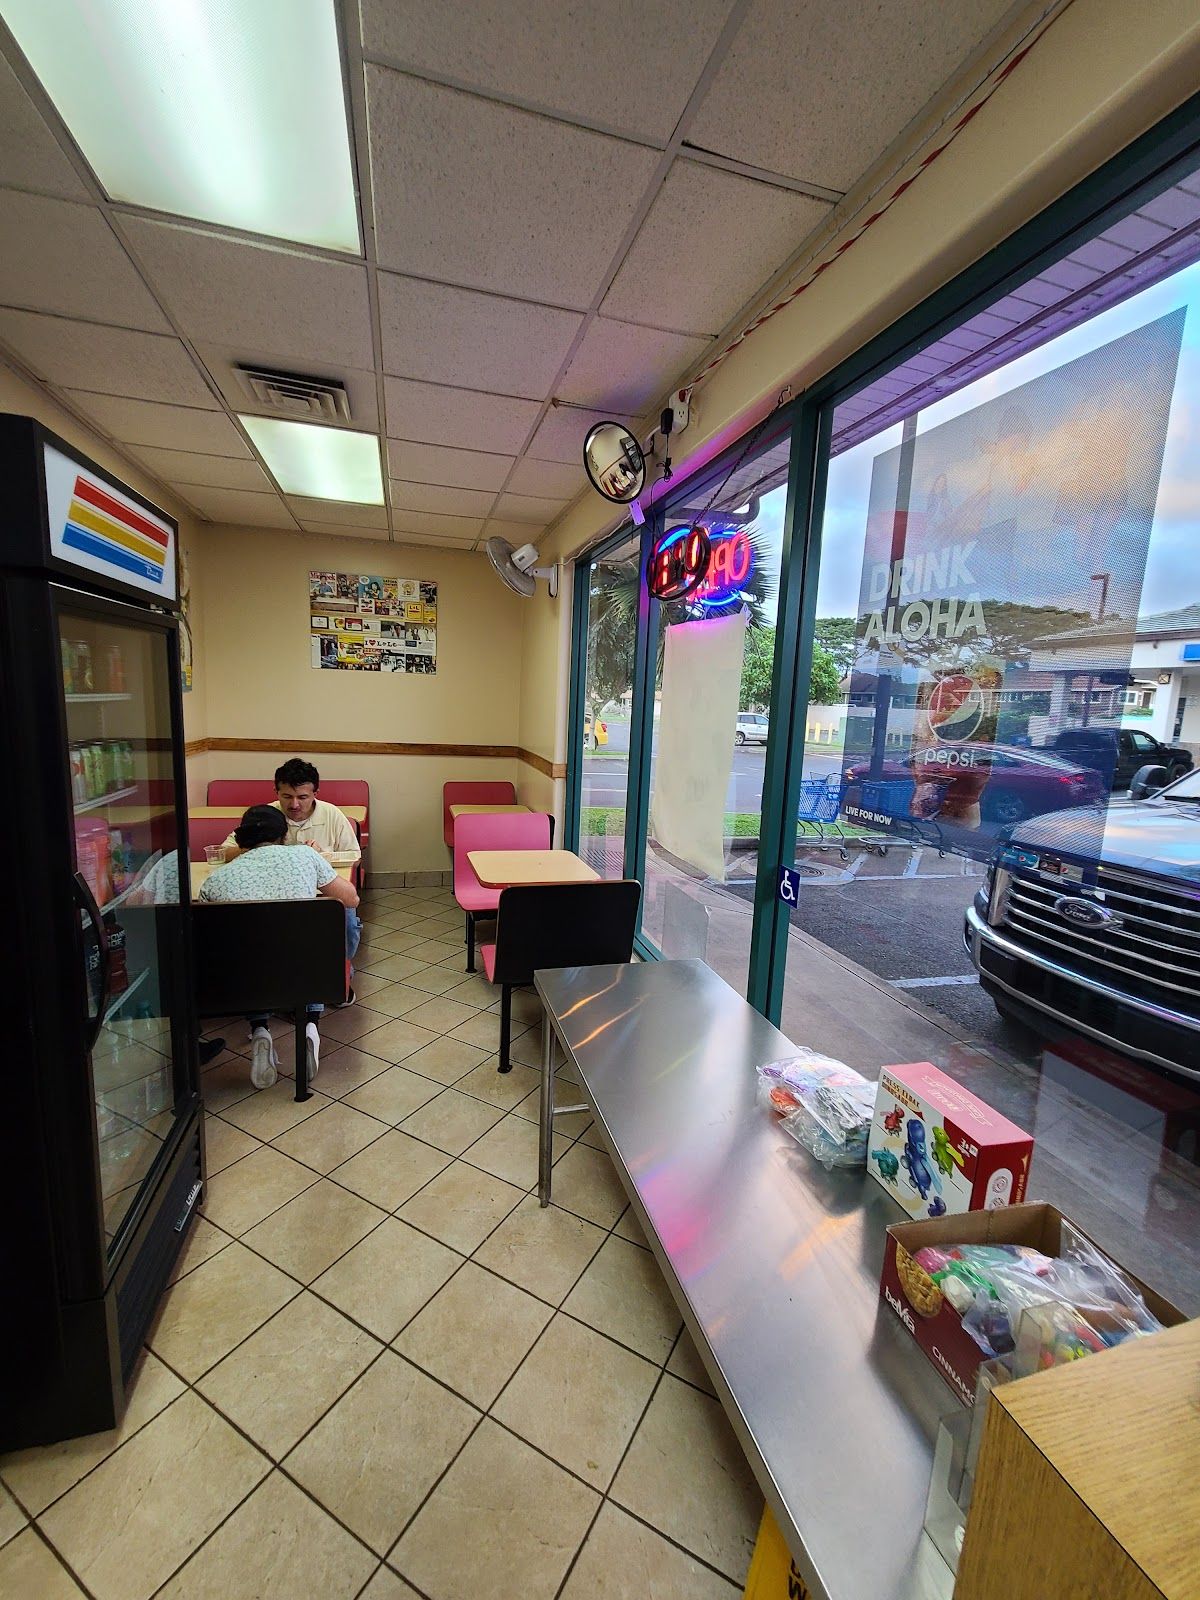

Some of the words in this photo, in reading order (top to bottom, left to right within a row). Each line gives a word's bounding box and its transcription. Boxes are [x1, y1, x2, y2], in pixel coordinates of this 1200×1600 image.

[868, 540, 977, 603] DRINK
[863, 592, 987, 645] ALOHA
[924, 747, 975, 769] pepsi
[845, 805, 858, 817] LIVE
[859, 809, 873, 821] FOR
[873, 812, 892, 826] NOW
[1064, 903, 1094, 922] Ford
